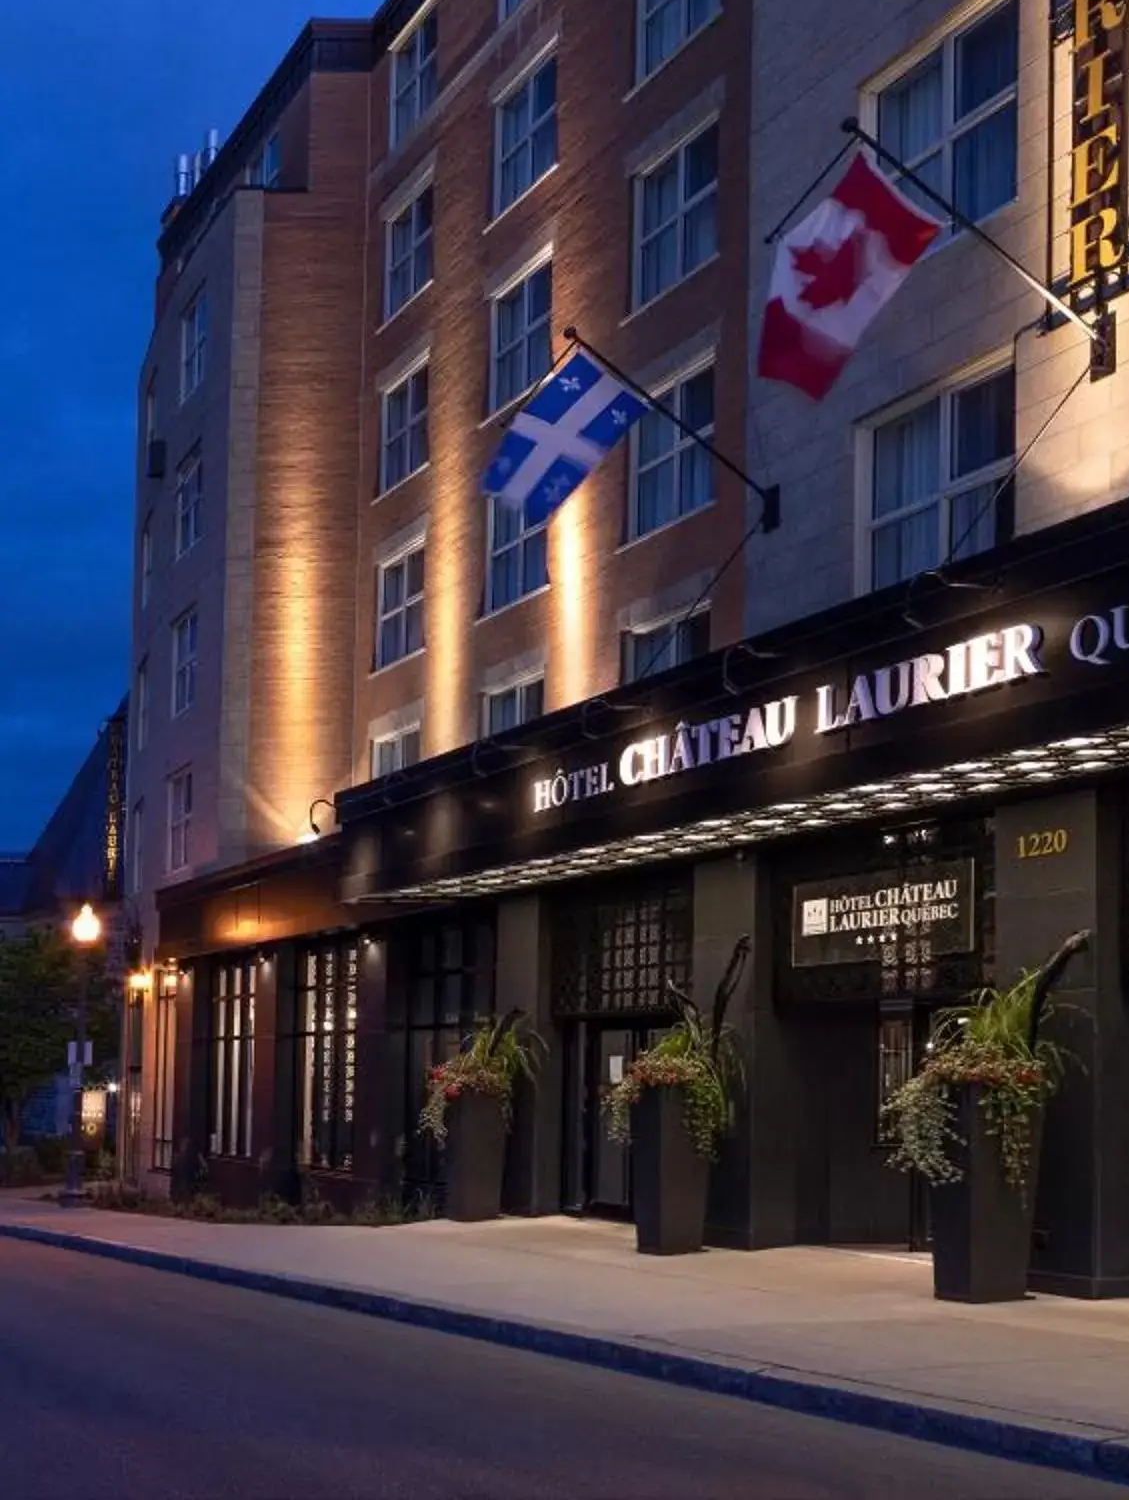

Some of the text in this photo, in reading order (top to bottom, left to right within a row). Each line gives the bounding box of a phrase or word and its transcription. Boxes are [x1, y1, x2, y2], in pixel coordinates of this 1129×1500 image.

[533, 762, 614, 813] HÔTEL
[619, 696, 799, 786] CHÂTEAU
[815, 622, 1046, 735] LAURIER
[1017, 829, 1067, 858] 1220
[830, 879, 958, 914] HÔTEL CHÂTEAU
[830, 903, 959, 932] LAURIER QUÉBEC
